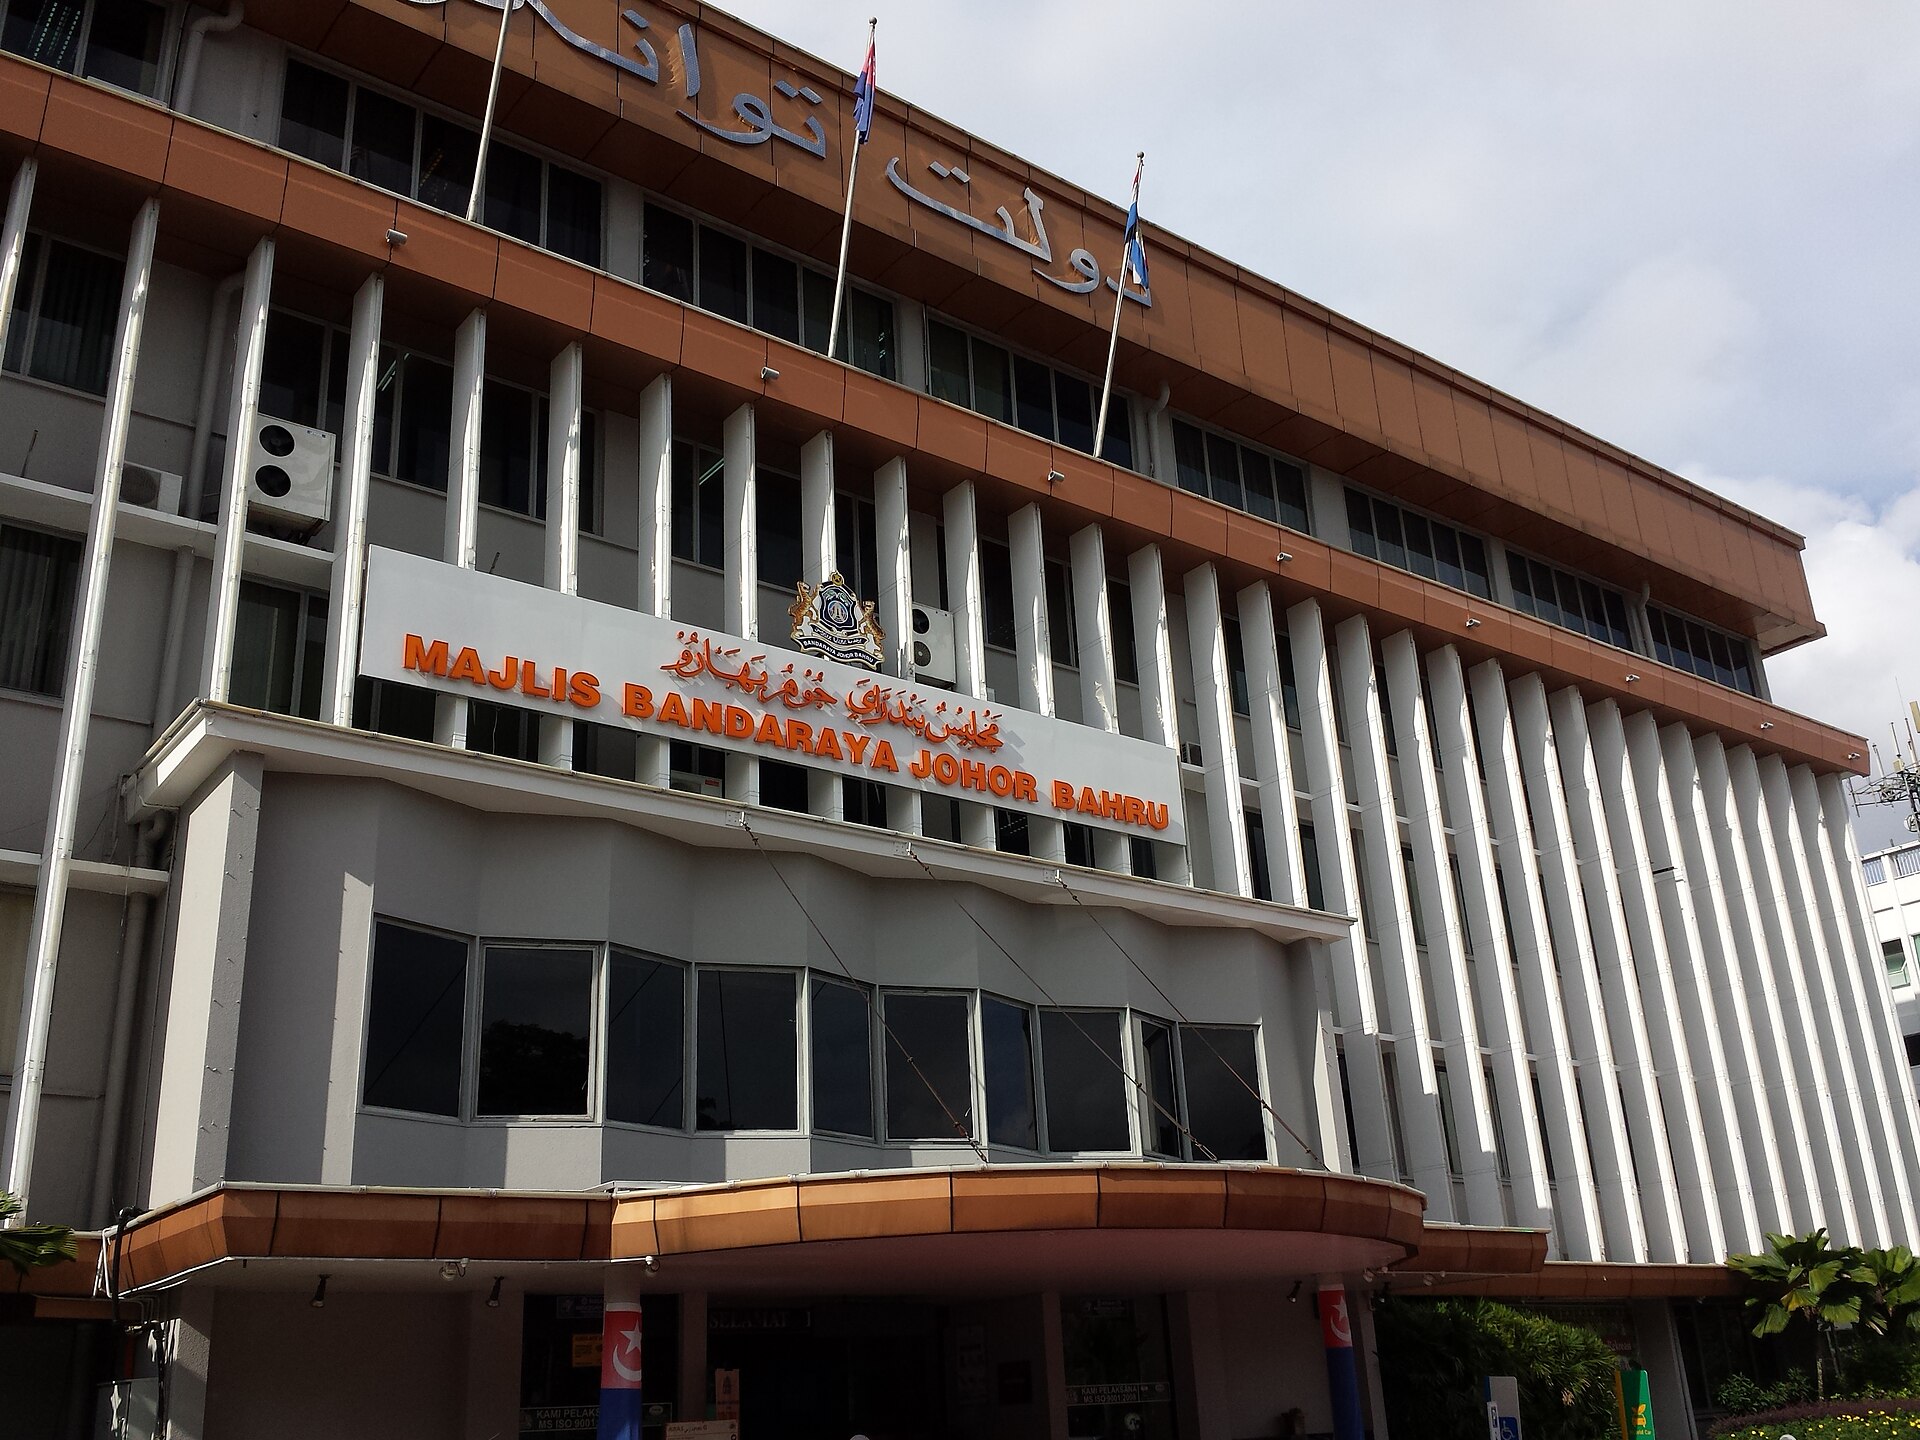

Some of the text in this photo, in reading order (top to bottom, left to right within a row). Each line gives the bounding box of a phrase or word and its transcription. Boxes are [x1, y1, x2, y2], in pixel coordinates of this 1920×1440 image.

[404, 633, 1169, 831] MAJLIS BANDARAYA JOHOR BAHRU
[536, 1407, 601, 1419] KAMI PELAKS
[538, 1420, 553, 1429] MS
[555, 1418, 573, 1428] ISO
